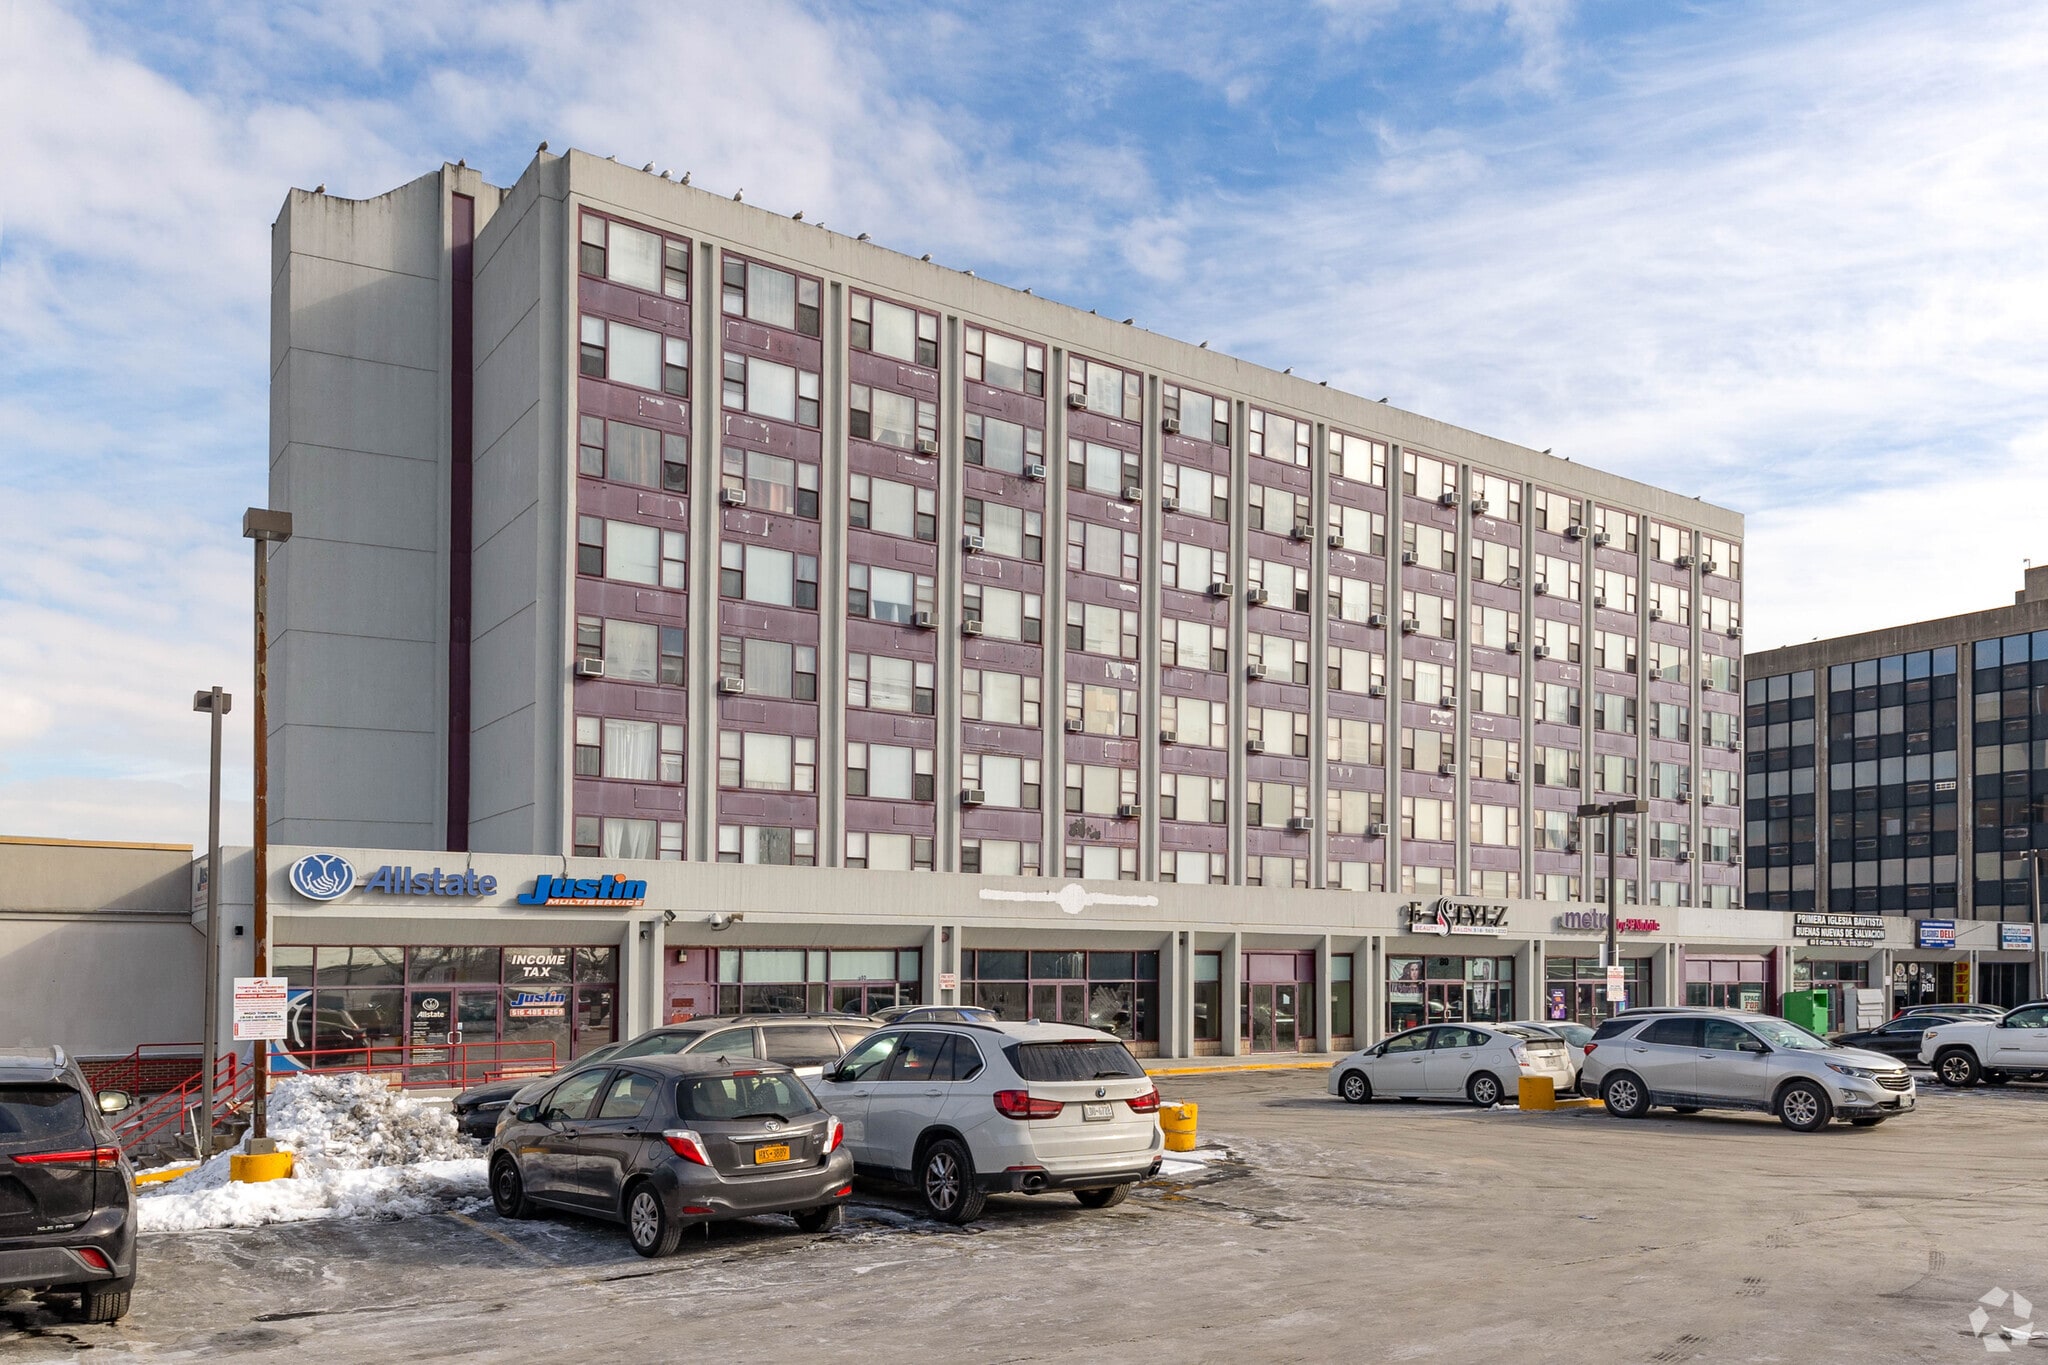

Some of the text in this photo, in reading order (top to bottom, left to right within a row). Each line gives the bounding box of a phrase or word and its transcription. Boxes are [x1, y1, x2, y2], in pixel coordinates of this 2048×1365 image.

[363, 865, 498, 897] Allstate
[517, 873, 648, 905] Justin
[547, 898, 643, 906] MULTISERVICE
[1797, 914, 1883, 927] PRIMERA IGLESIA BAUTISTA
[1796, 927, 1885, 939] BUENAS NUEVAS DE SALVACION
[1940, 930, 1954, 939] DELI
[511, 955, 566, 965] INCOME
[523, 967, 551, 977] TAX
[1921, 983, 1935, 993] DELI
[511, 991, 566, 1006] Justin
